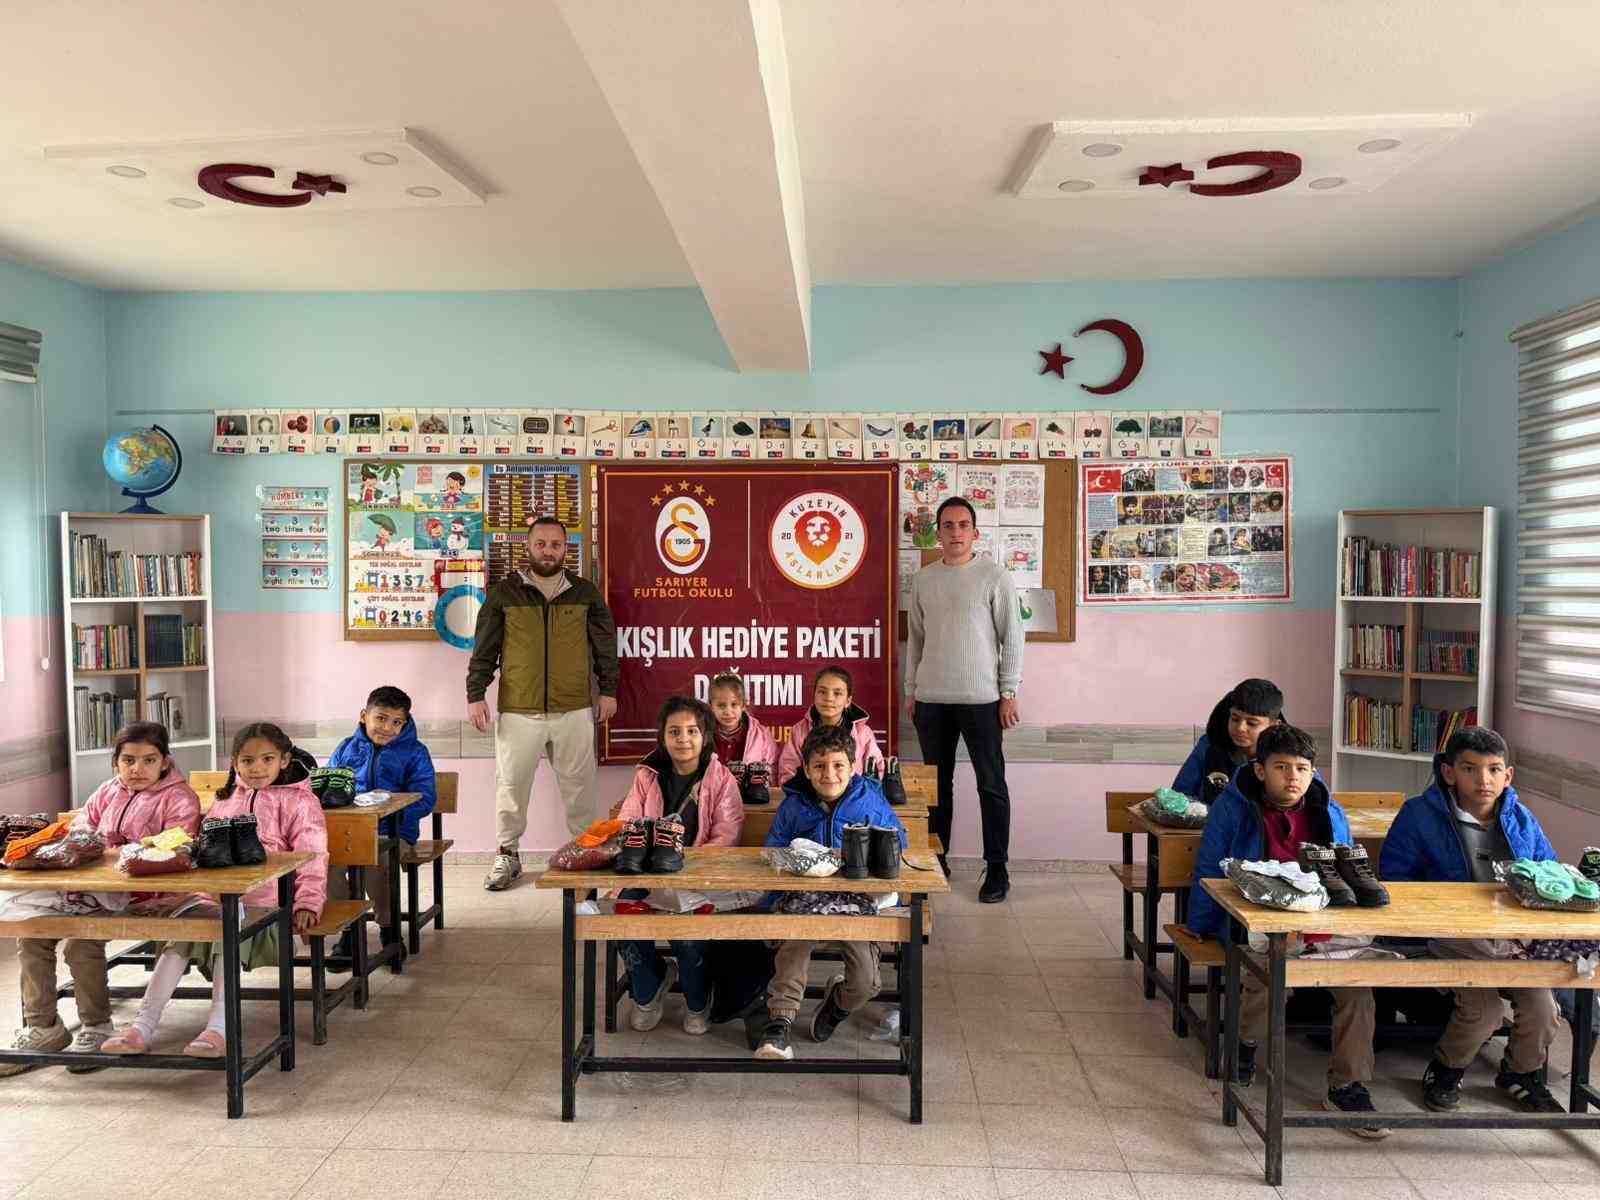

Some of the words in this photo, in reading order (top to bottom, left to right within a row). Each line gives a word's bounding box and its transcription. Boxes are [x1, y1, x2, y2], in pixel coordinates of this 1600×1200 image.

[655, 577, 708, 587] SARIYER
[634, 588, 685, 598] FUTBOL
[689, 588, 733, 598] OKULU
[391, 610, 399, 622] 2
[403, 610, 411, 622] 4
[415, 610, 423, 622] 6
[617, 626, 694, 667] KIŞLIK
[702, 619, 789, 658] HEDİYE
[797, 619, 881, 658] PAKETİ
[694, 666, 802, 706] DITIMI
